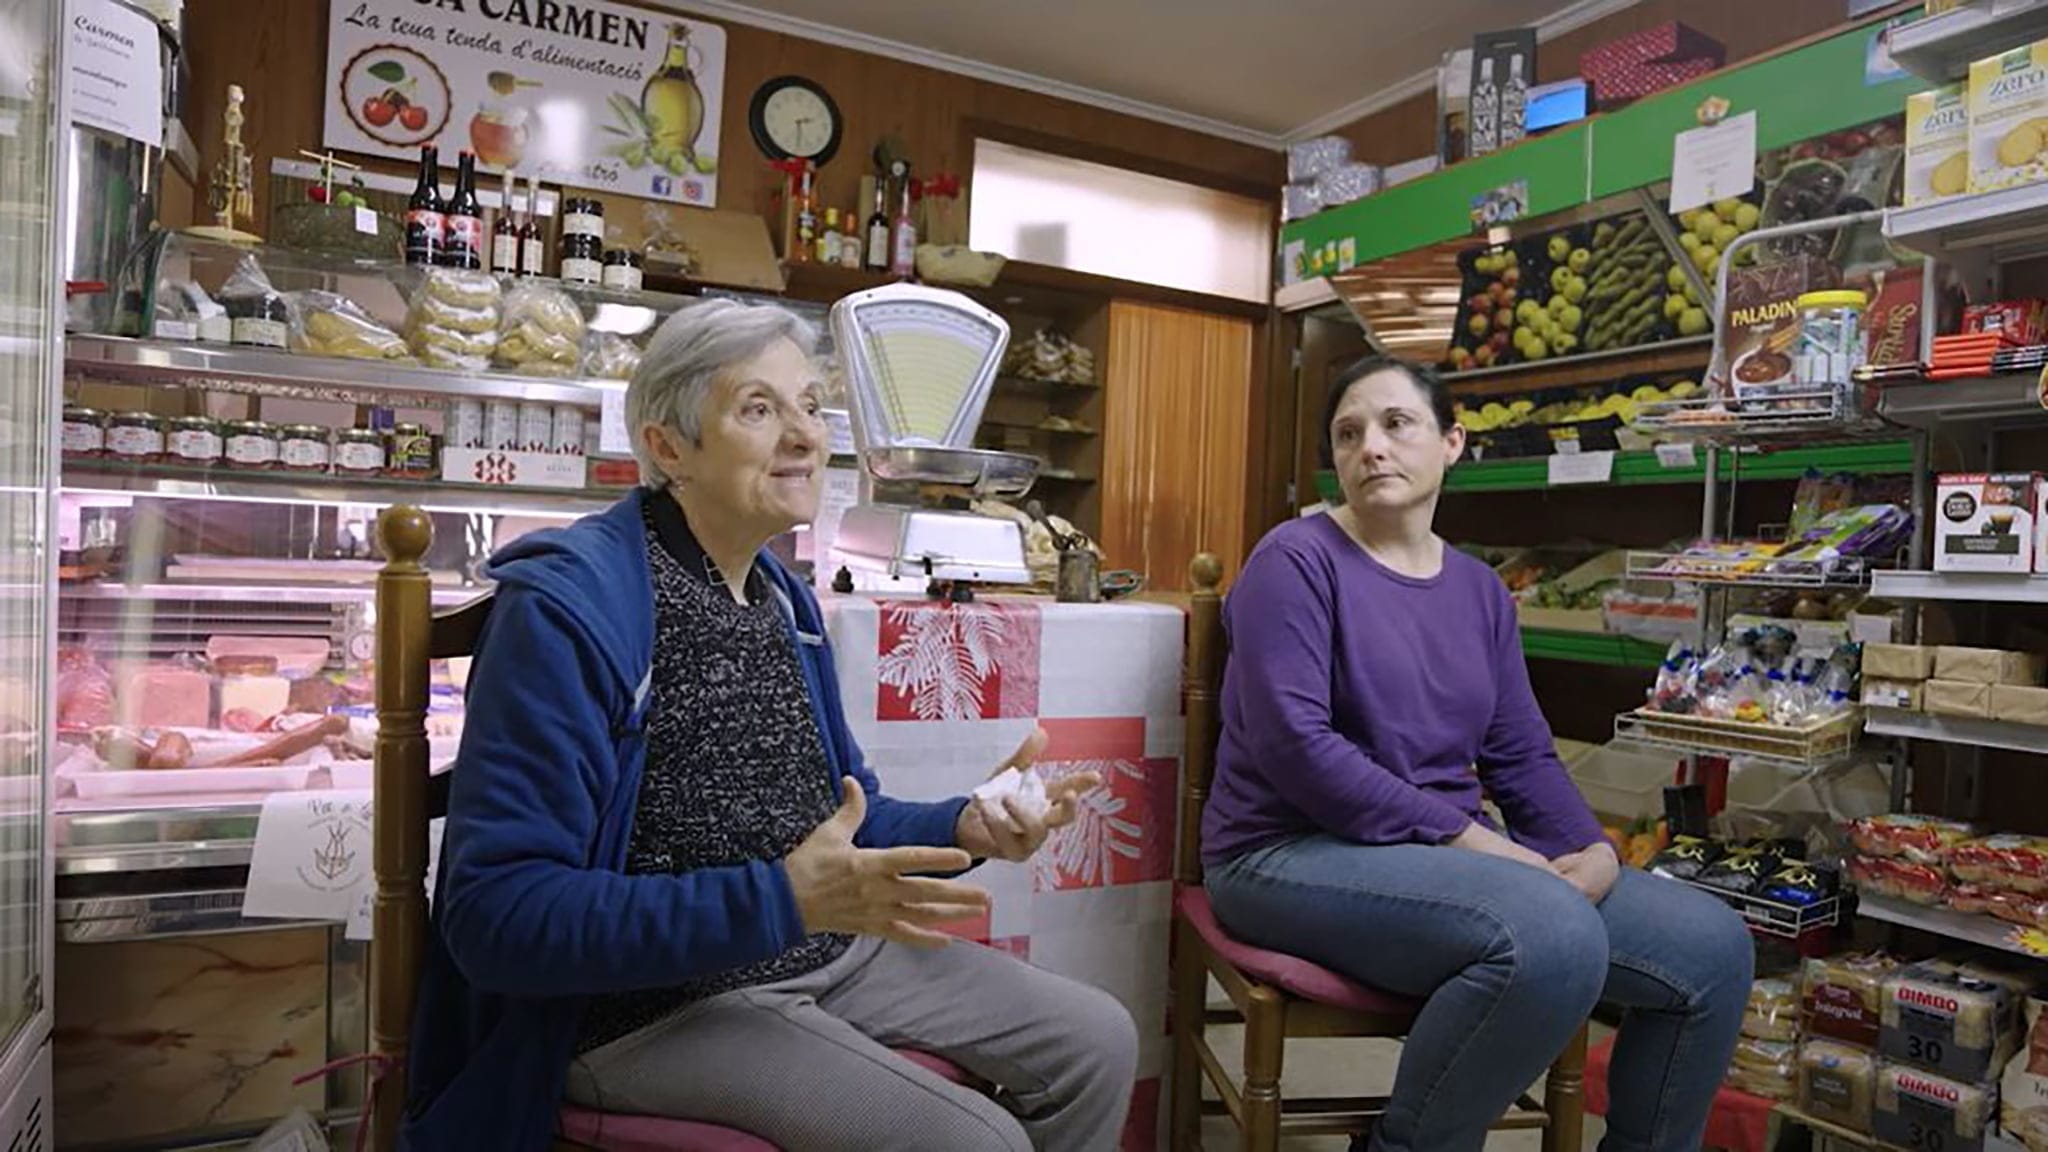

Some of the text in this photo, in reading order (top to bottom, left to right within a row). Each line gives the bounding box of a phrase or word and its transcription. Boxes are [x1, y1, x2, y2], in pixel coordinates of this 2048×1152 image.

[74, 15, 134, 48] Carmen
[479, 0, 649, 50] CARMEN
[344, 3, 643, 81] La teua tenda d'alimentació
[1731, 300, 1798, 328] PALADIN
[1879, 302, 1918, 365] Surtid
[1898, 987, 1959, 1014] BIMBO
[1907, 1034, 1943, 1063] 30
[1897, 1073, 1959, 1101] BIMBO
[1908, 1121, 1943, 1152] 30
